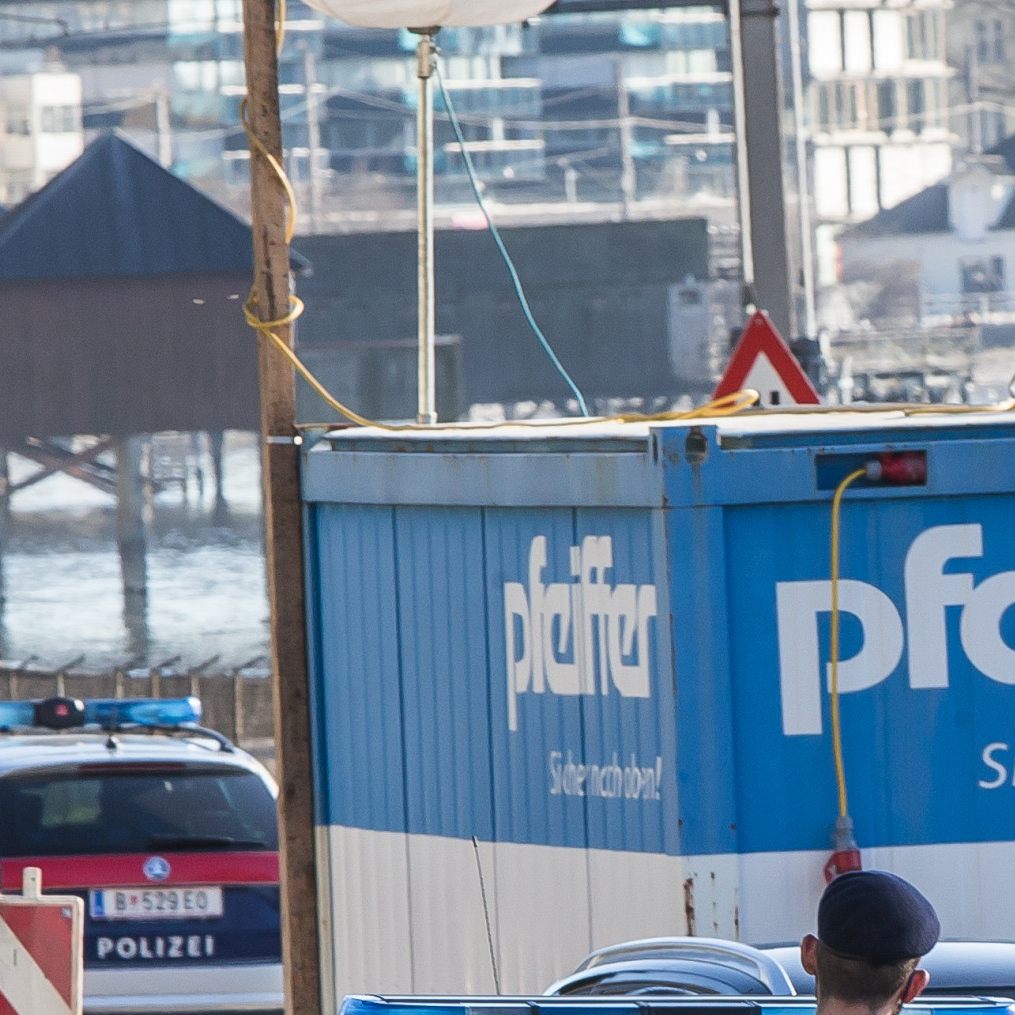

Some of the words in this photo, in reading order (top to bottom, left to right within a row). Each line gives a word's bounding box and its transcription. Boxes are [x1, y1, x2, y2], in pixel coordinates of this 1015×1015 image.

[504, 535, 657, 732] pfeiffer
[549, 750, 586, 797] Siche
[97, 934, 215, 959] POLIZEI
